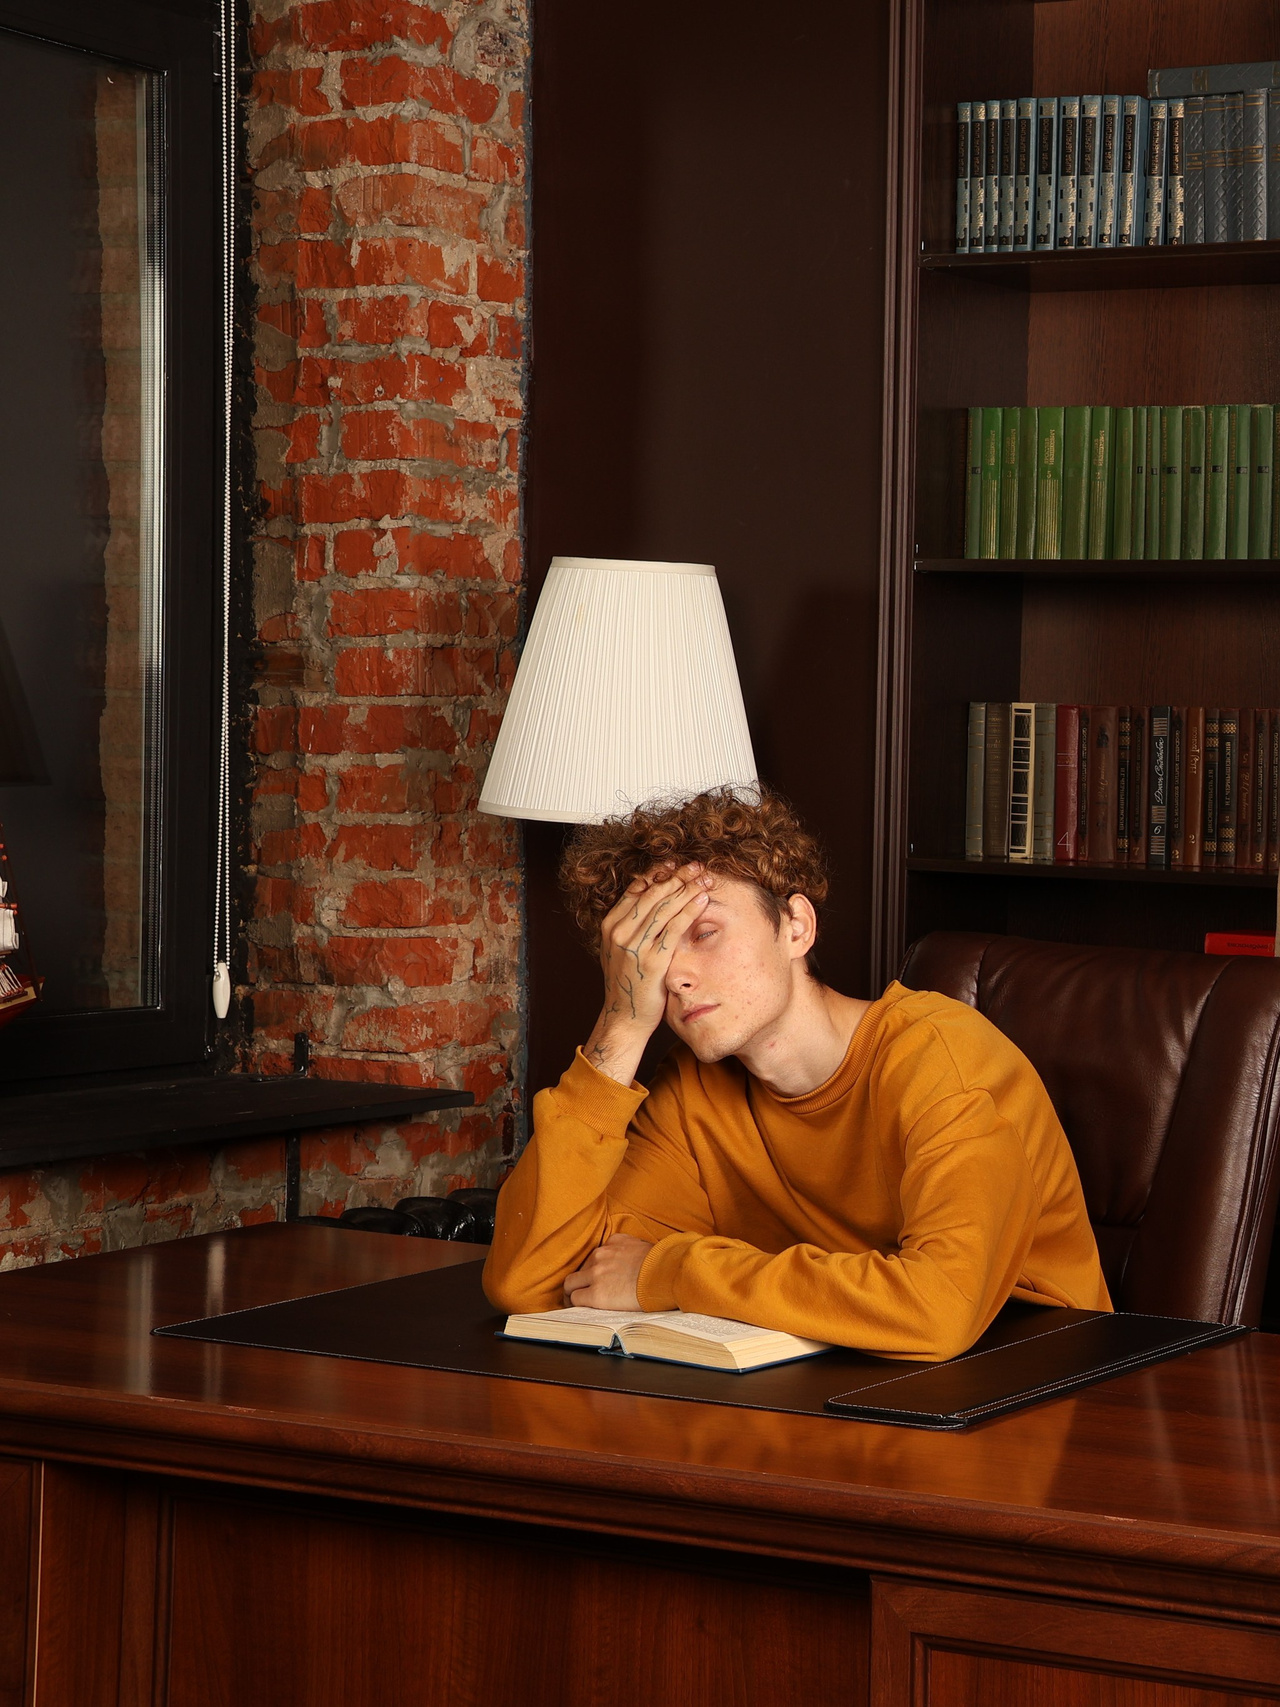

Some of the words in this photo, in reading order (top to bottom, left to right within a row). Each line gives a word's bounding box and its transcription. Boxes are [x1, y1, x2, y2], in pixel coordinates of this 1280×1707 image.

[1057, 831, 1071, 851] 4
[1189, 834, 1195, 844] 2
[1255, 852, 1263, 863] 8
